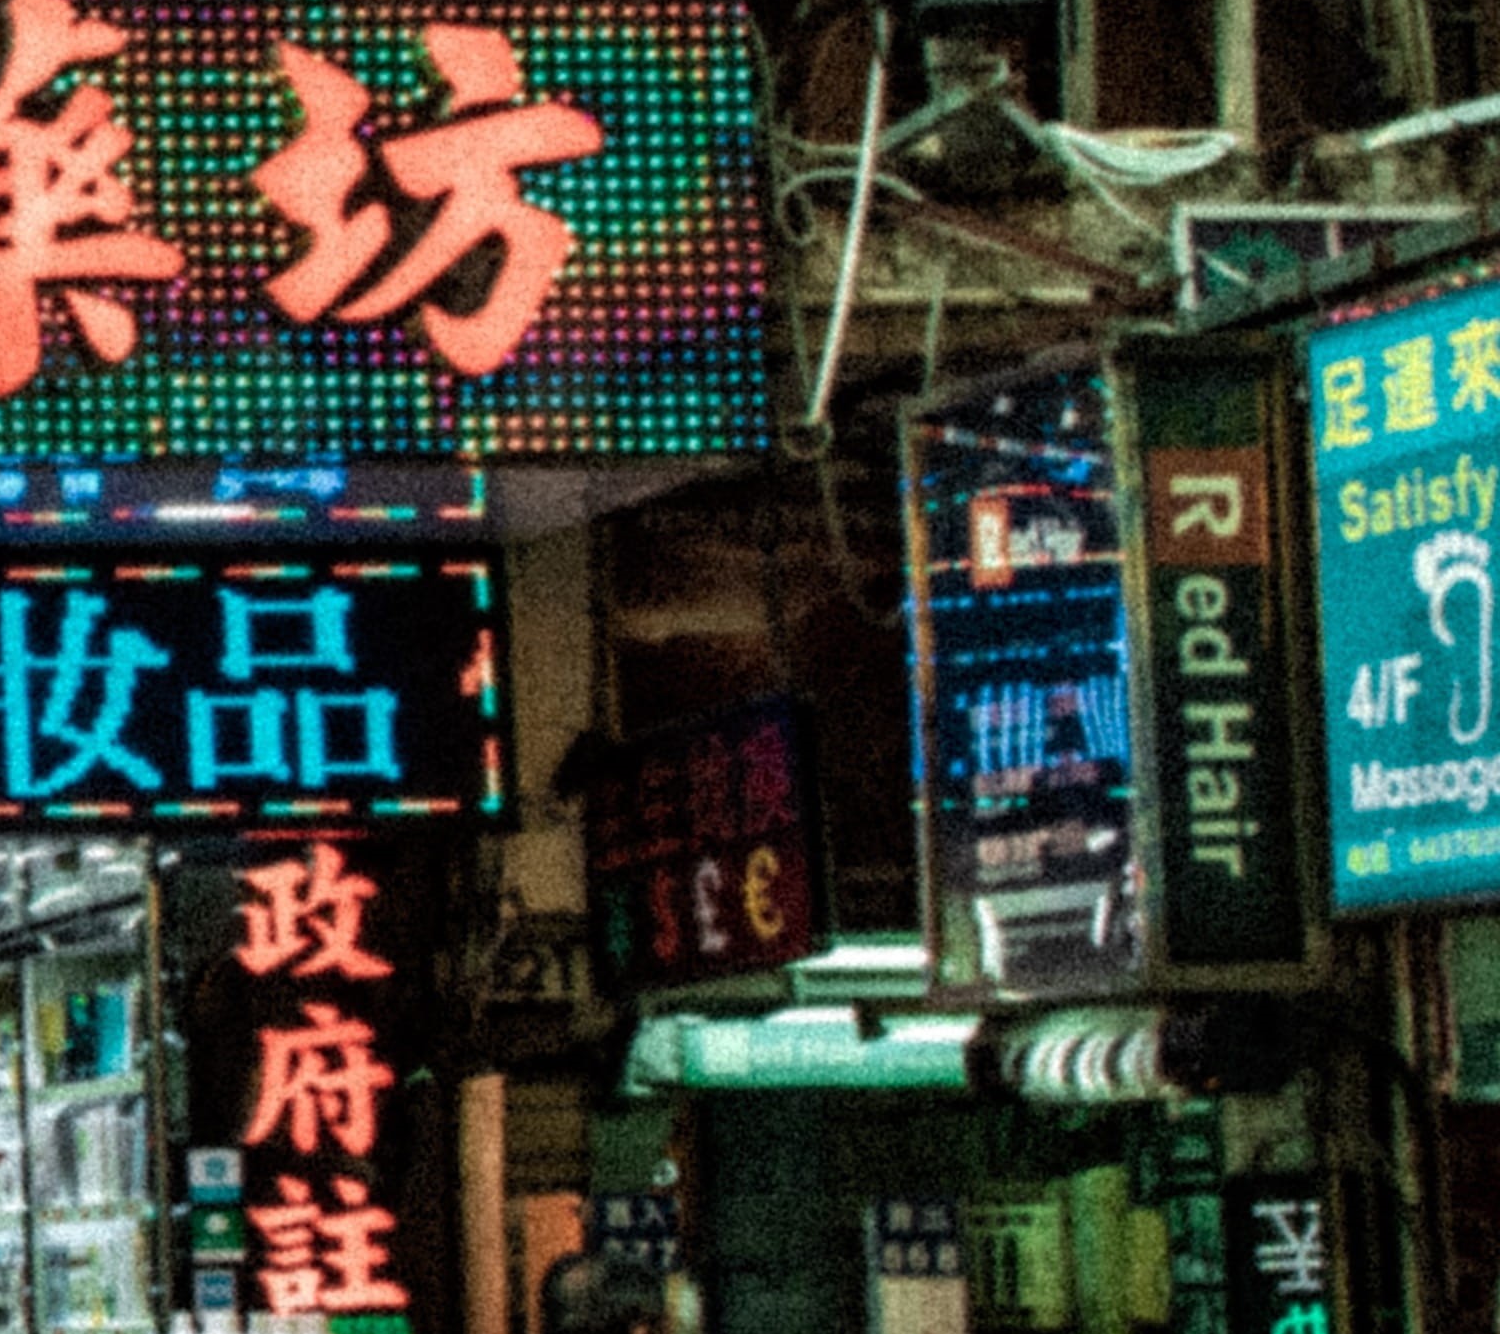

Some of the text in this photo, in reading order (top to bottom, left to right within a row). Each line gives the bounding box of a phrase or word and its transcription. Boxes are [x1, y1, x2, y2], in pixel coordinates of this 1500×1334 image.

[1338, 453, 1499, 545] Satisfy
[1346, 653, 1422, 730] 4/F
[1176, 707, 1258, 879] Hair
[234, 839, 412, 1315] 政府註
